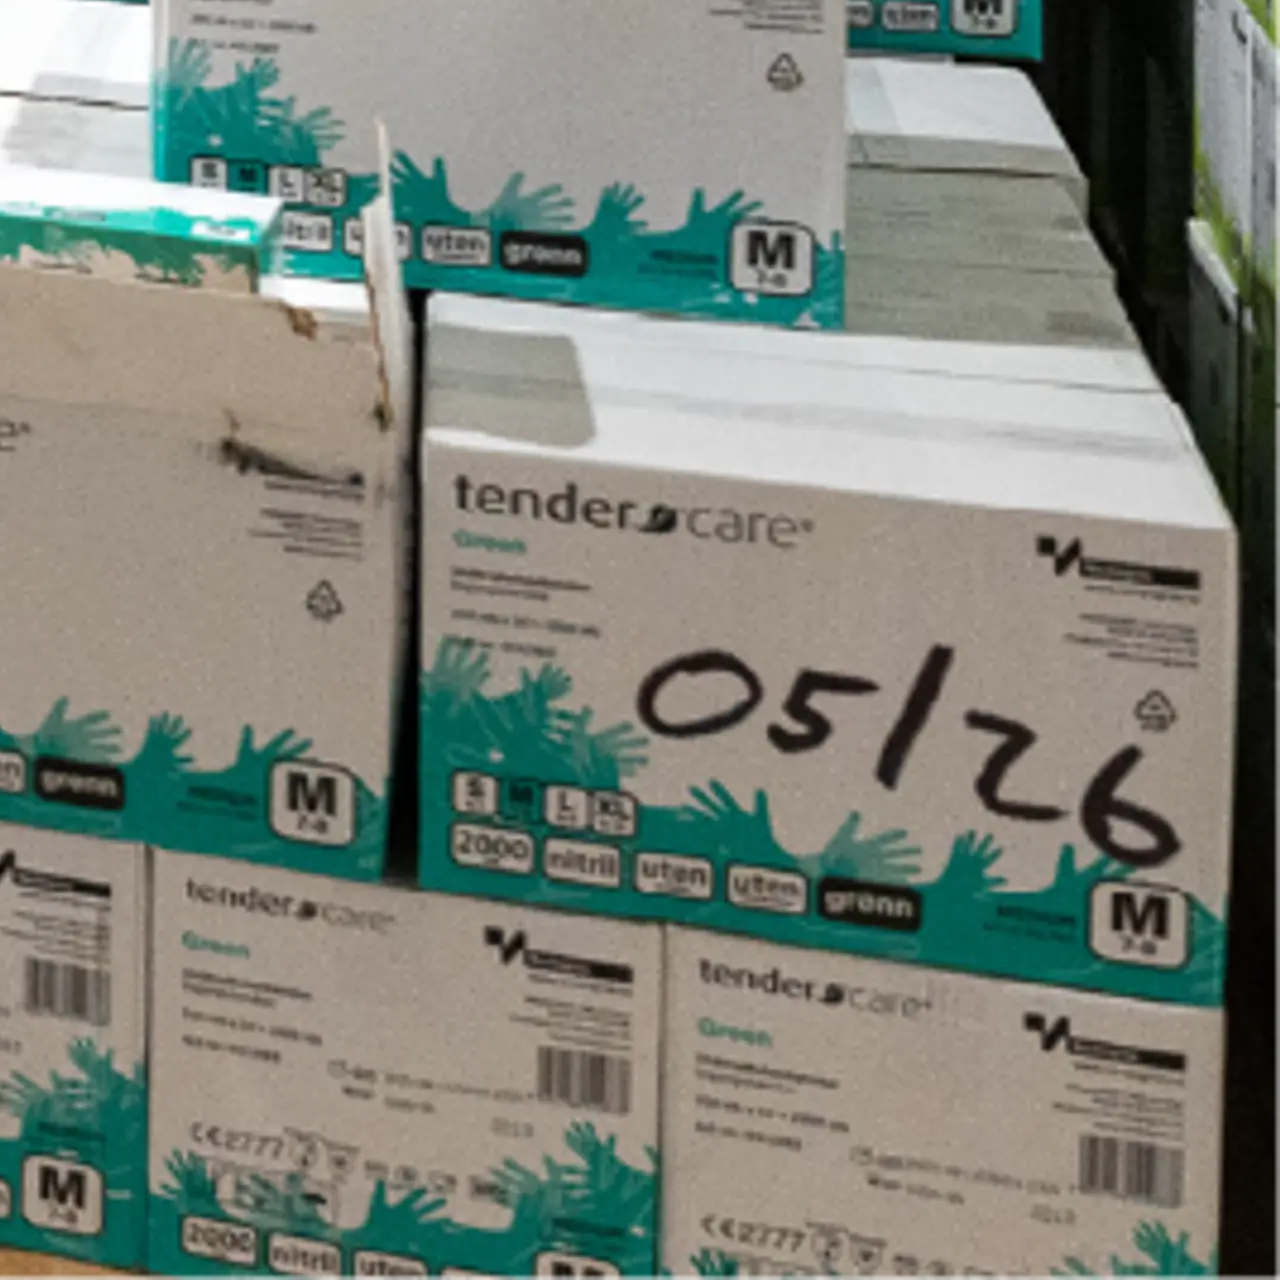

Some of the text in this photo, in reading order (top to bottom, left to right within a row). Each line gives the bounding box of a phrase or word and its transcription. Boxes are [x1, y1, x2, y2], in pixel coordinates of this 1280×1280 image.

[748, 230, 794, 269] M
[455, 475, 798, 549] tender care
[634, 645, 1181, 870] 05/26
[288, 772, 336, 815] M
[456, 827, 531, 859] 2000
[547, 845, 617, 879] nitril
[641, 856, 708, 886] uten
[186, 879, 294, 916] tender
[1112, 892, 1168, 938] M
[699, 959, 814, 1001] tender
[39, 1166, 85, 1209] M
